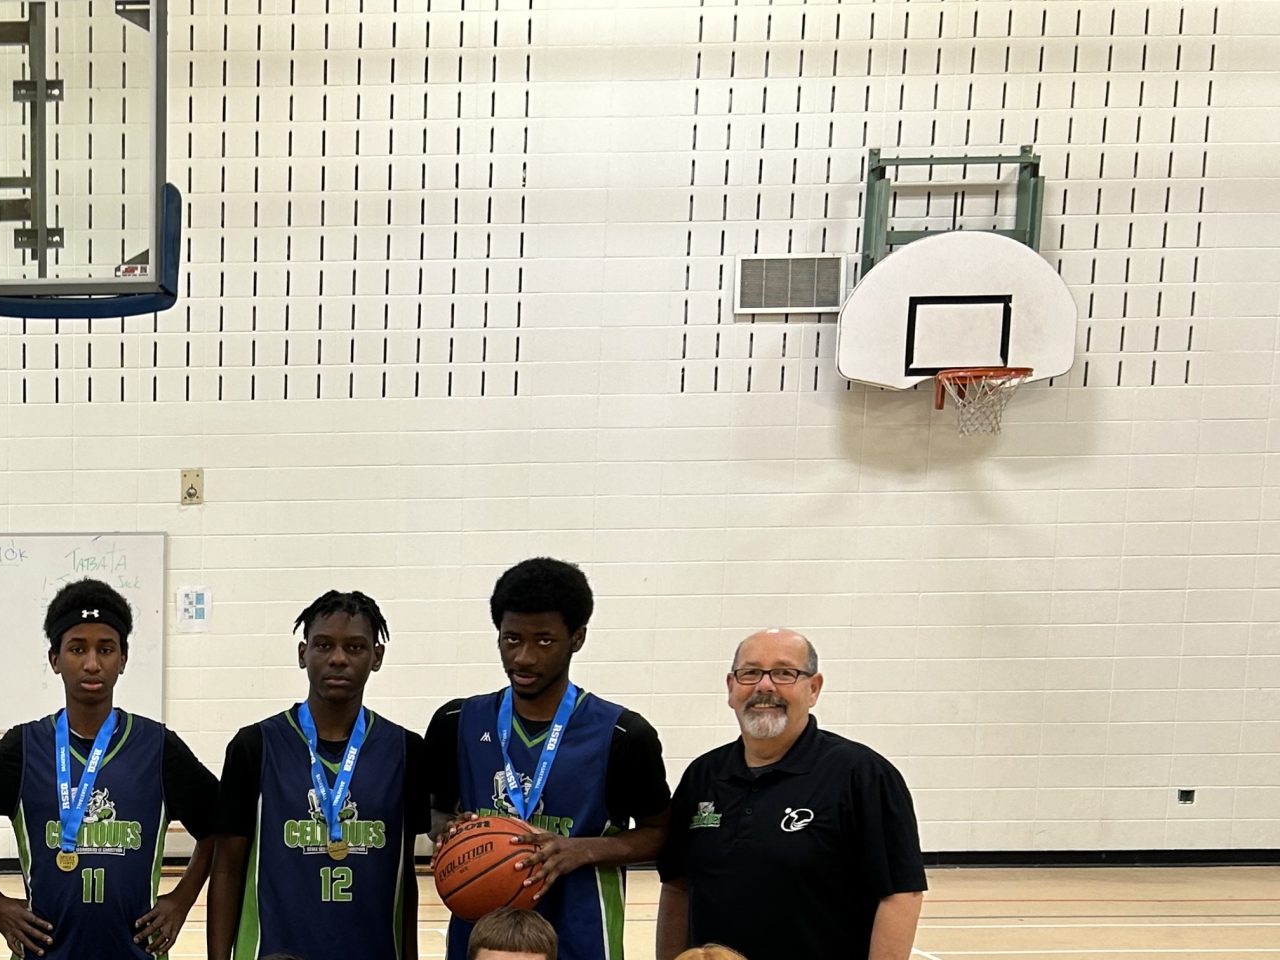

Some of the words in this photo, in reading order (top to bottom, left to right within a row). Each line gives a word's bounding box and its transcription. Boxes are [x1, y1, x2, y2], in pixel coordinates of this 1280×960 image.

[547, 723, 562, 751] RSEQ
[87, 749, 102, 773] RSEQ
[343, 746, 358, 772] RSEQ
[62, 782, 70, 809] RSEQ
[438, 840, 494, 882] EVOLUTION
[81, 867, 105, 904] 11
[320, 866, 353, 902] 12
